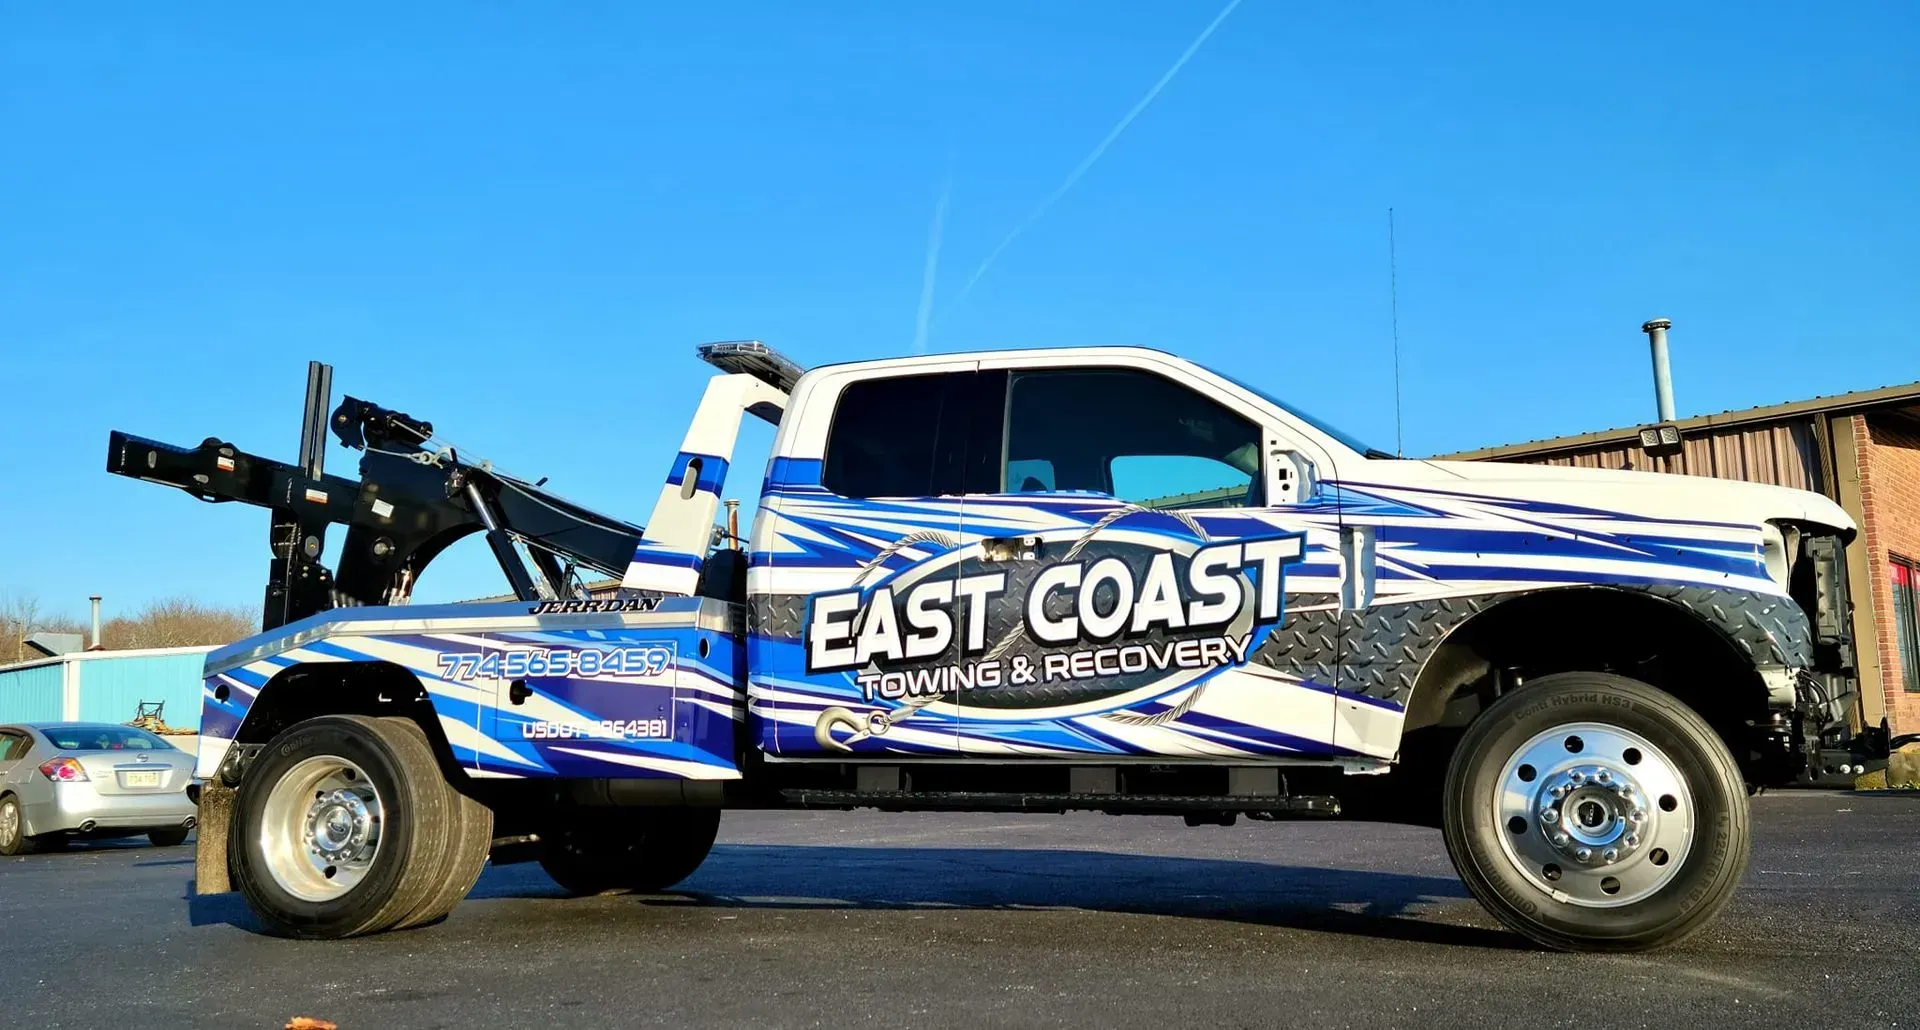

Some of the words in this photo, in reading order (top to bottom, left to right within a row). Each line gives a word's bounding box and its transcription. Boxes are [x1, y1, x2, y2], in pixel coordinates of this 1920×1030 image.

[809, 573, 1008, 671] EAST
[1028, 536, 1303, 642] COAST
[439, 648, 672, 680] 774-565-8459
[857, 660, 1001, 700] TOWING
[1010, 656, 1037, 683] &
[1045, 633, 1253, 681] RECOVERY
[1549, 693, 1599, 708] Hybrid
[1602, 694, 1631, 709] HS3
